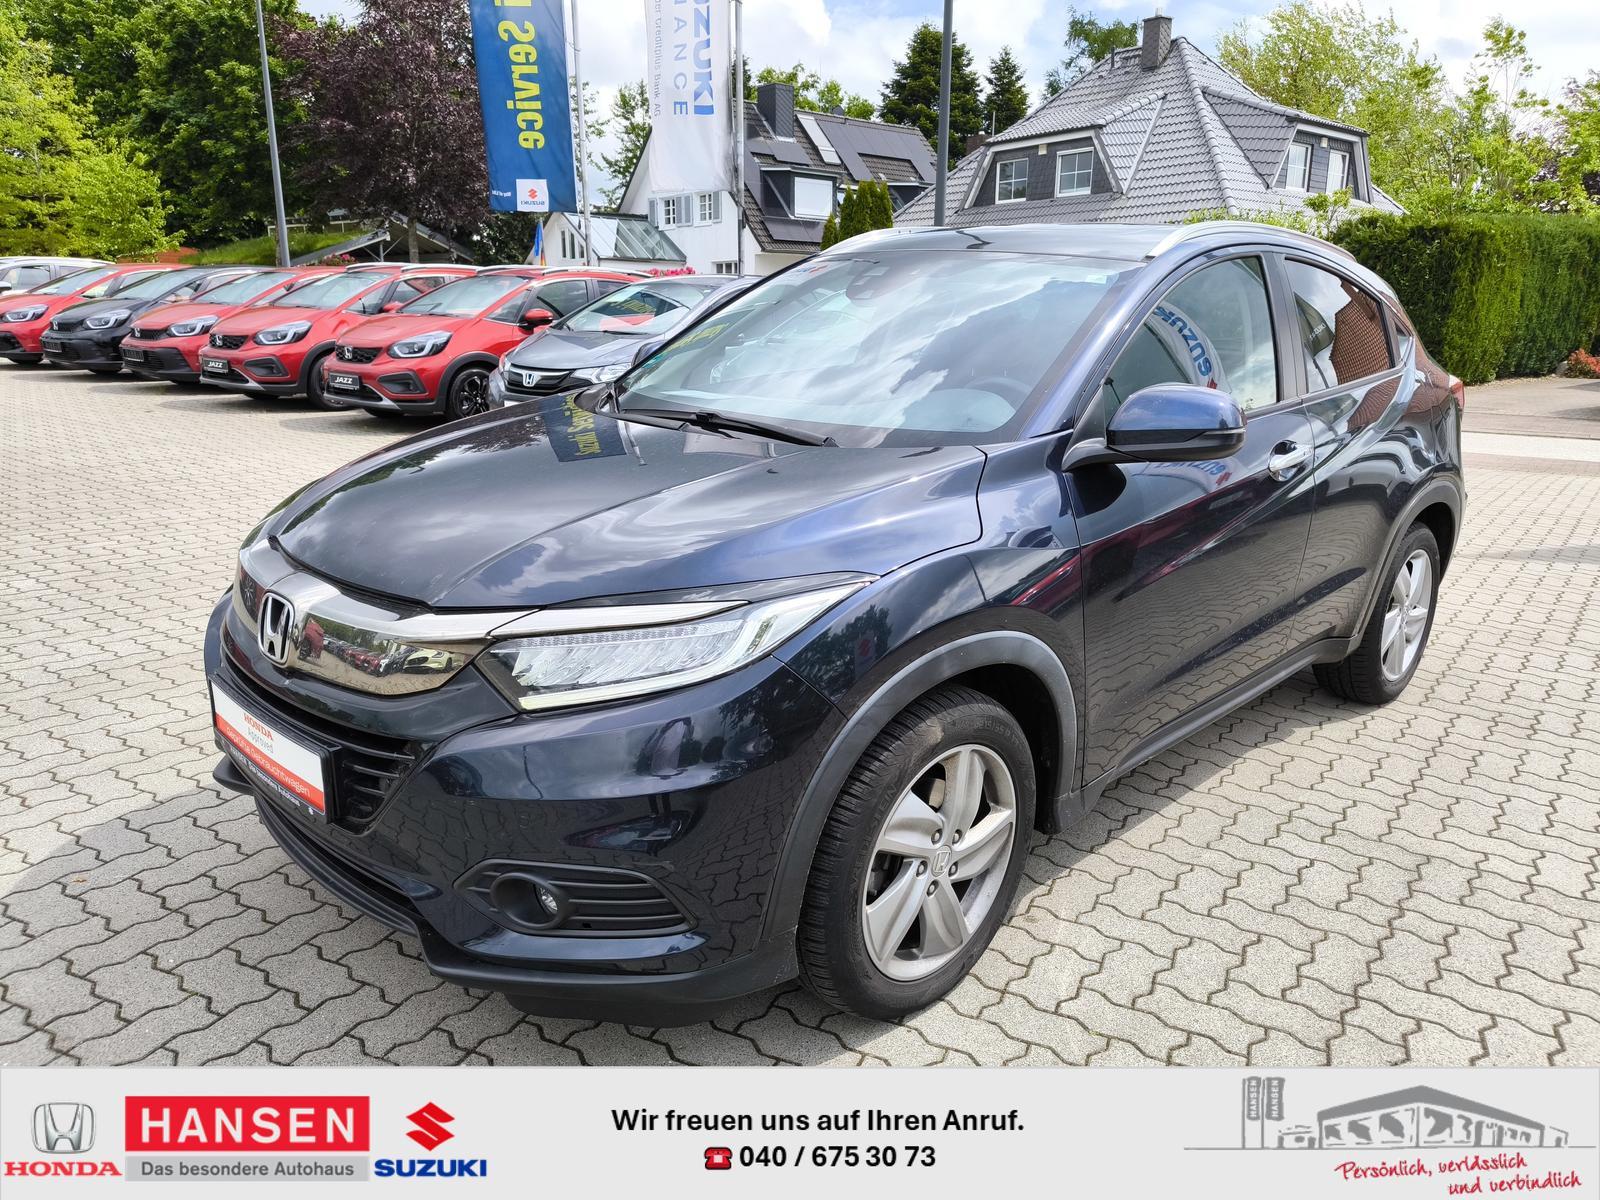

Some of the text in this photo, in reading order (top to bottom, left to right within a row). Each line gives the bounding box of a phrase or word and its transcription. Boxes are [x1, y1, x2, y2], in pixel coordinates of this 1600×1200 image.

[693, 0, 714, 114] ZUKI
[207, 361, 223, 369] JAZZ
[335, 376, 353, 385] JAZZ
[243, 712, 274, 741] HONDA
